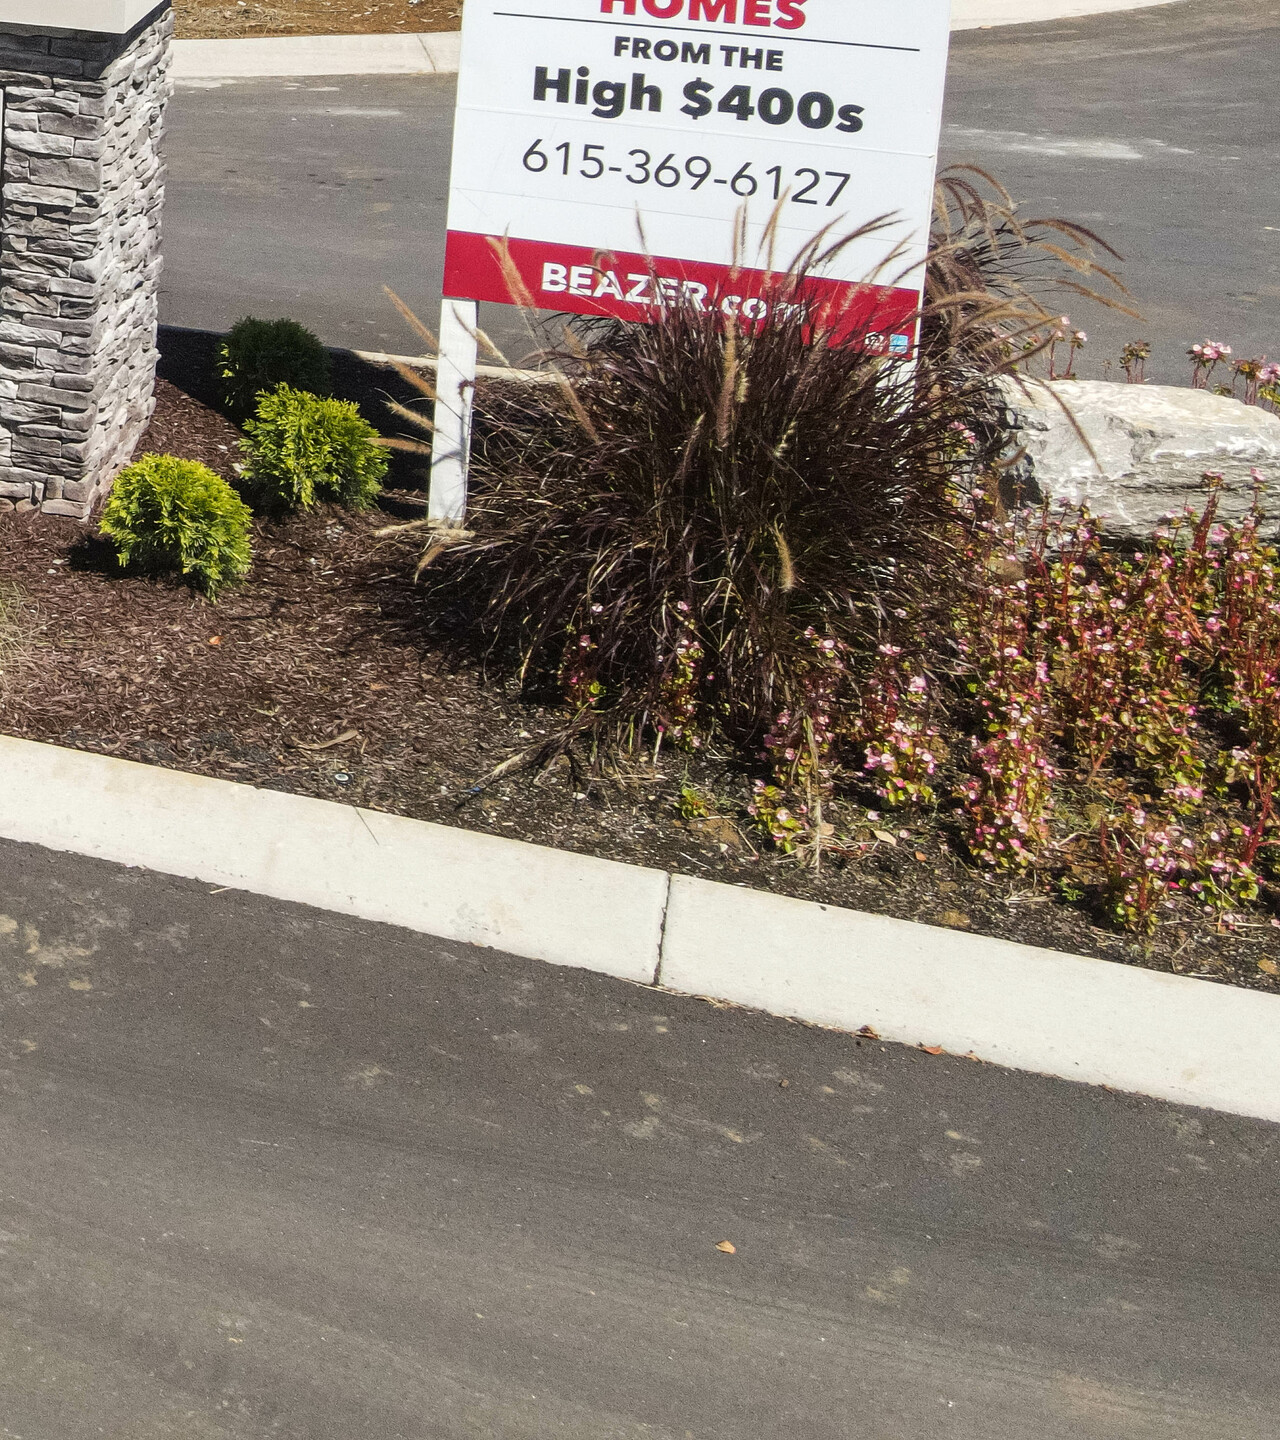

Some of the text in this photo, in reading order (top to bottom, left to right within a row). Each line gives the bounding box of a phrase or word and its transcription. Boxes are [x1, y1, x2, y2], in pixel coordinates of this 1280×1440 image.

[614, 36, 784, 72] FROM THE
[533, 66, 865, 133] High $400s
[522, 138, 851, 207] 615-369-6127
